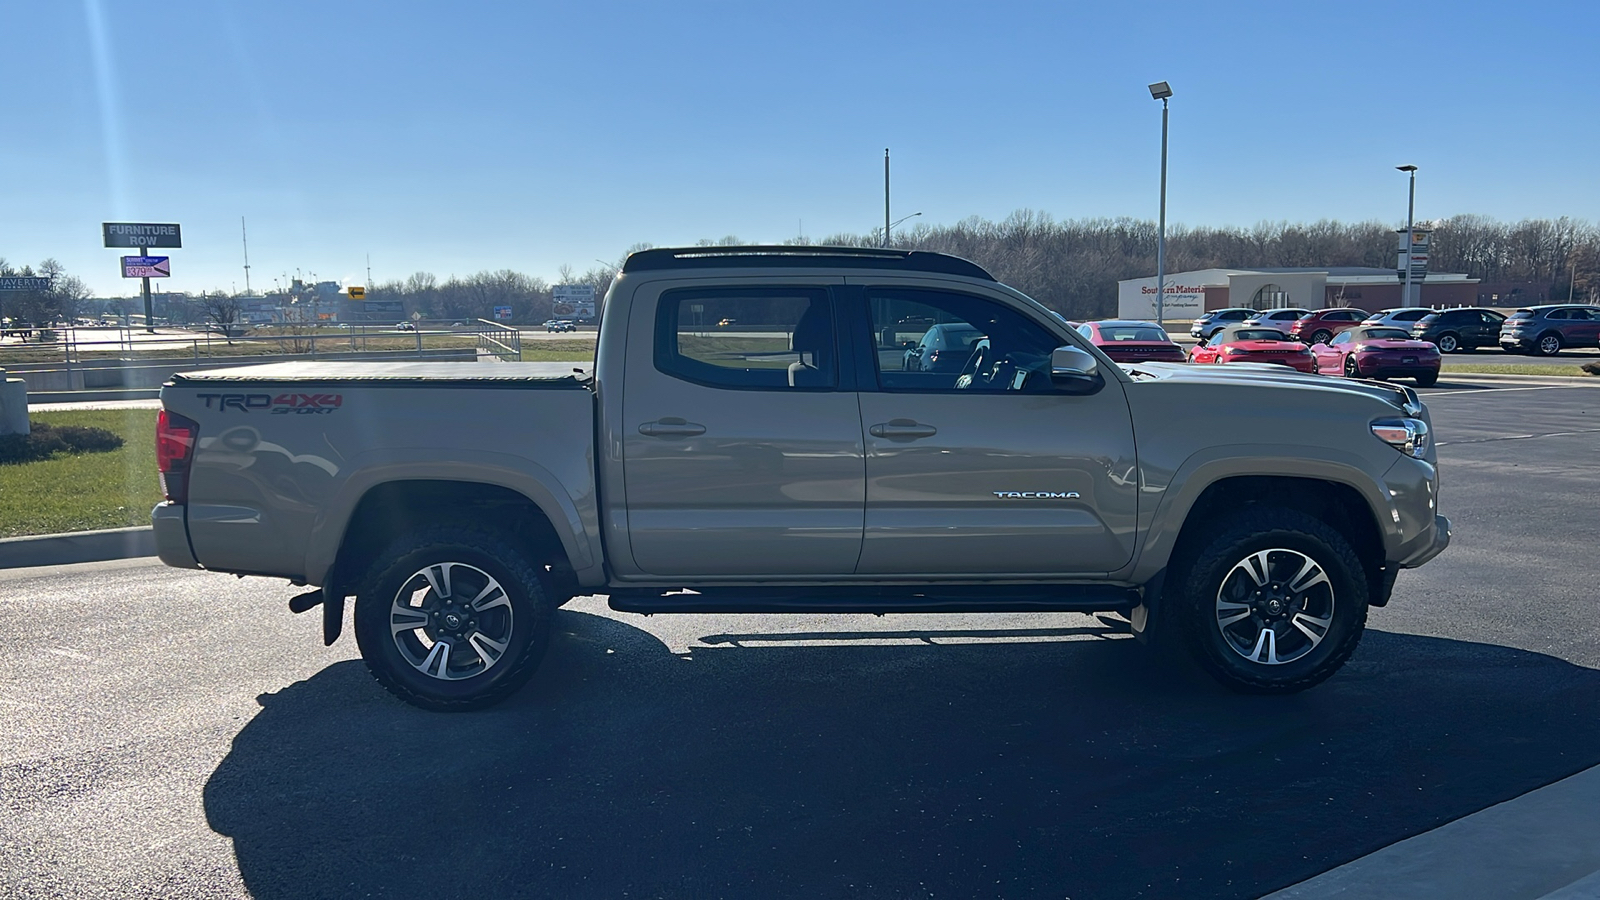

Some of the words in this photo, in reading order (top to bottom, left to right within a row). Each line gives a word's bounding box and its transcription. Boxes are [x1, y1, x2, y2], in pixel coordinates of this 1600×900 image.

[109, 225, 176, 235] FURNITURE
[129, 236, 157, 245] ROW
[196, 393, 272, 413] TRD
[270, 407, 339, 415] SPORT
[993, 491, 1080, 499] TACOMA
